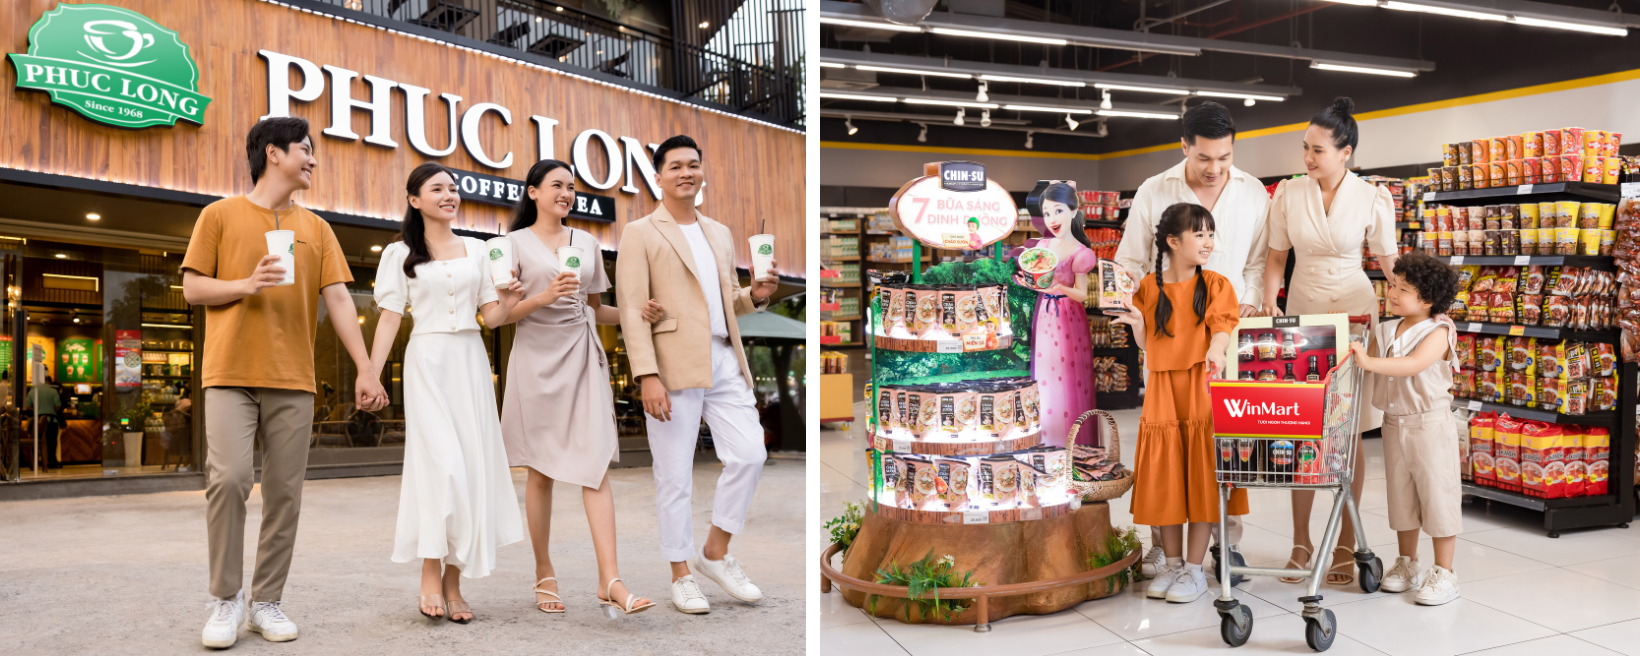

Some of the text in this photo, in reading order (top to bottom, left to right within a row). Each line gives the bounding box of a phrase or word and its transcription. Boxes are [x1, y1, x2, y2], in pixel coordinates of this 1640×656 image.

[24, 63, 199, 116] PHUC LONG
[85, 100, 143, 119] Since 1968
[259, 49, 706, 206] PHUC LON
[943, 169, 985, 182] CHIN-SU
[453, 172, 603, 216] OFFE EA
[937, 197, 1000, 211] BỮA SÁNG
[912, 197, 930, 224] 7
[928, 214, 959, 225] DINH
[1223, 398, 1300, 418] WinMart
